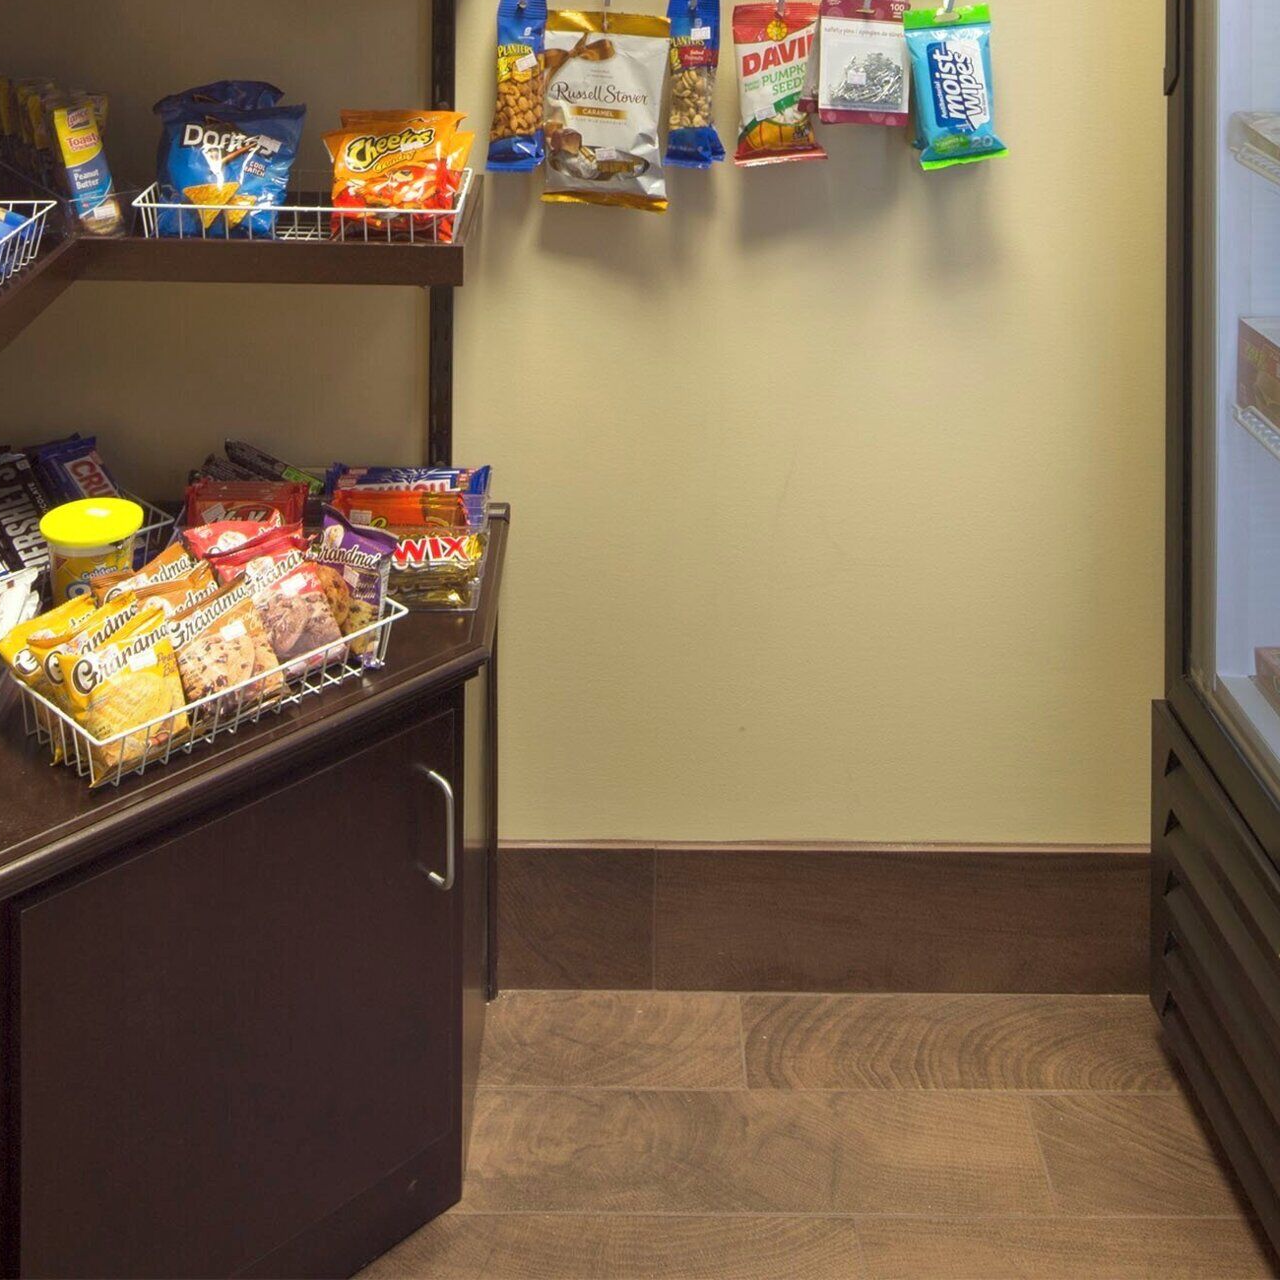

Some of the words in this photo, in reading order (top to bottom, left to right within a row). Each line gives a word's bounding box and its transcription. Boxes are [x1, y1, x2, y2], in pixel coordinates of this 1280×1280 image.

[890, 3, 905, 11] 100
[932, 48, 967, 120] moist
[954, 51, 984, 117] wipes
[551, 81, 603, 105] Russell
[604, 84, 649, 106] Stover
[581, 108, 615, 118] CARAMEL
[348, 128, 434, 168] Cheetos
[249, 161, 266, 170] COOL
[374, 151, 416, 173] Crunchy
[74, 169, 99, 180] Peanut
[243, 166, 266, 177] RANCH
[76, 179, 99, 190] Butter
[390, 536, 472, 569] WIX
[81, 566, 118, 580] Golden
